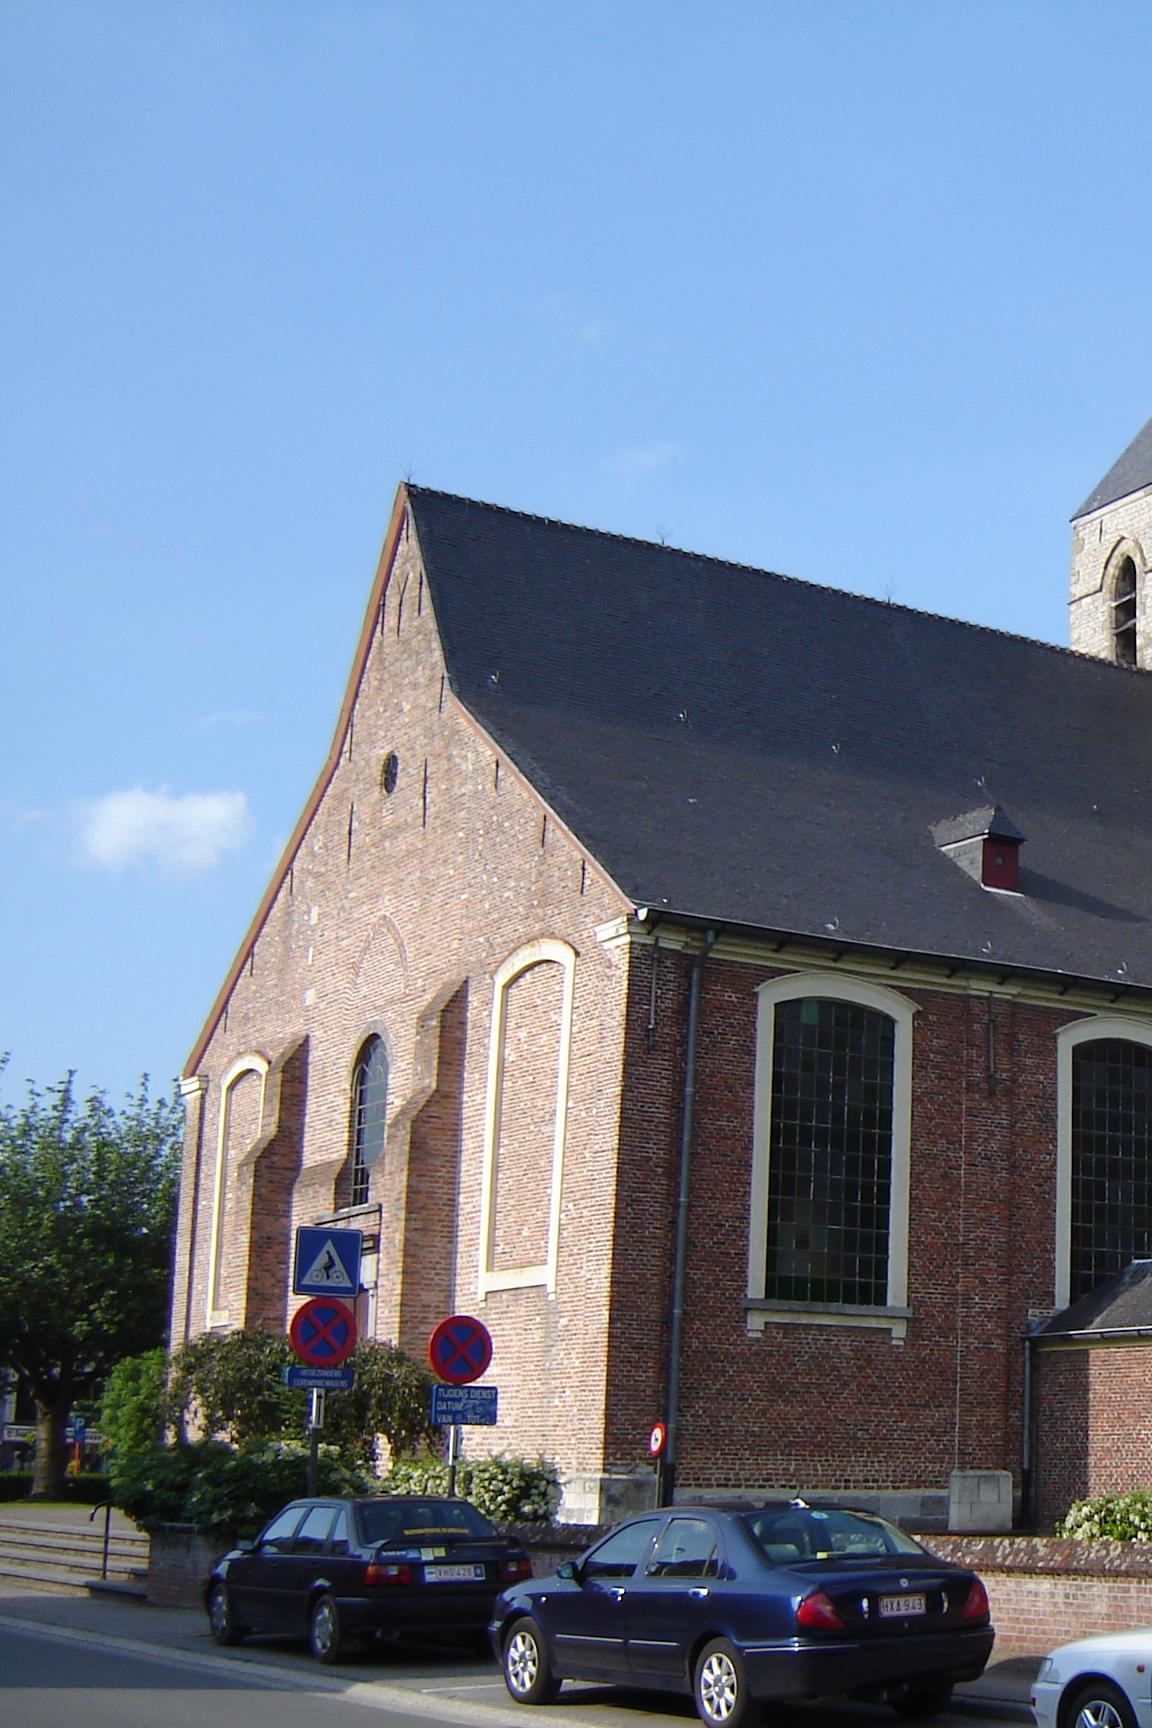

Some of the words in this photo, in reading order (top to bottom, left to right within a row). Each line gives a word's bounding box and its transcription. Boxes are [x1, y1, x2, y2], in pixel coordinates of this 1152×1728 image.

[437, 1388, 469, 1399] TIJDENS
[470, 1389, 497, 1399] DIENST
[436, 1401, 464, 1411] DATUM
[76, 1417, 86, 1431] P
[436, 1413, 453, 1423] VAN
[467, 1415, 480, 1424] TOT
